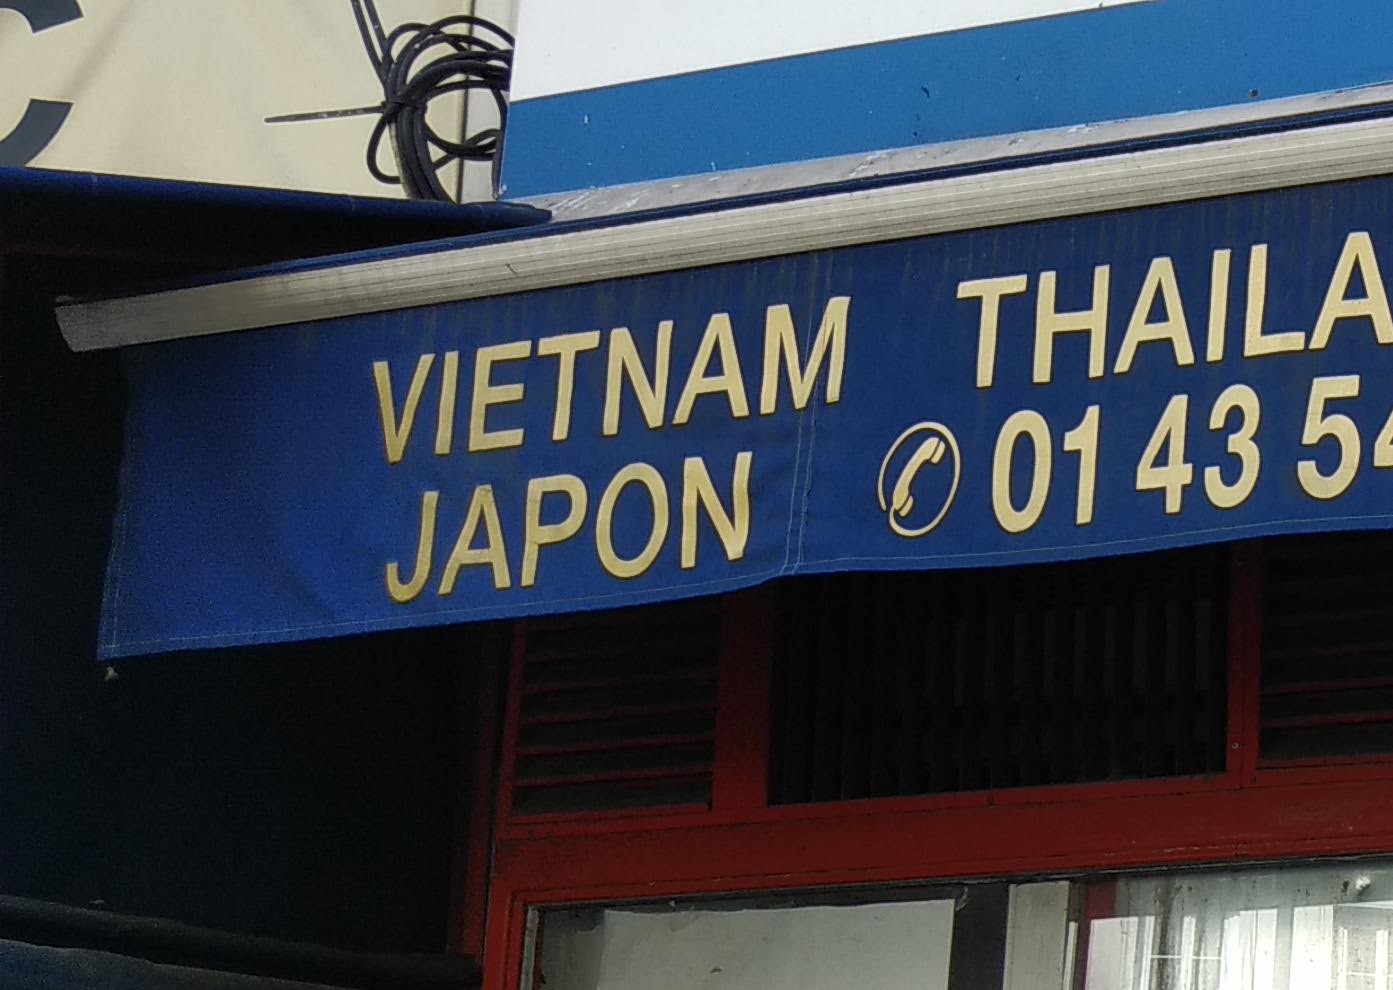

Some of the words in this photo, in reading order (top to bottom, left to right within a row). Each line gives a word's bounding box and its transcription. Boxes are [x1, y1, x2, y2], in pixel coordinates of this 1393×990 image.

[371, 295, 852, 464] VIETNAM
[385, 450, 754, 603] JAPON
[992, 403, 1102, 534] 01
[1135, 383, 1261, 515] 43
